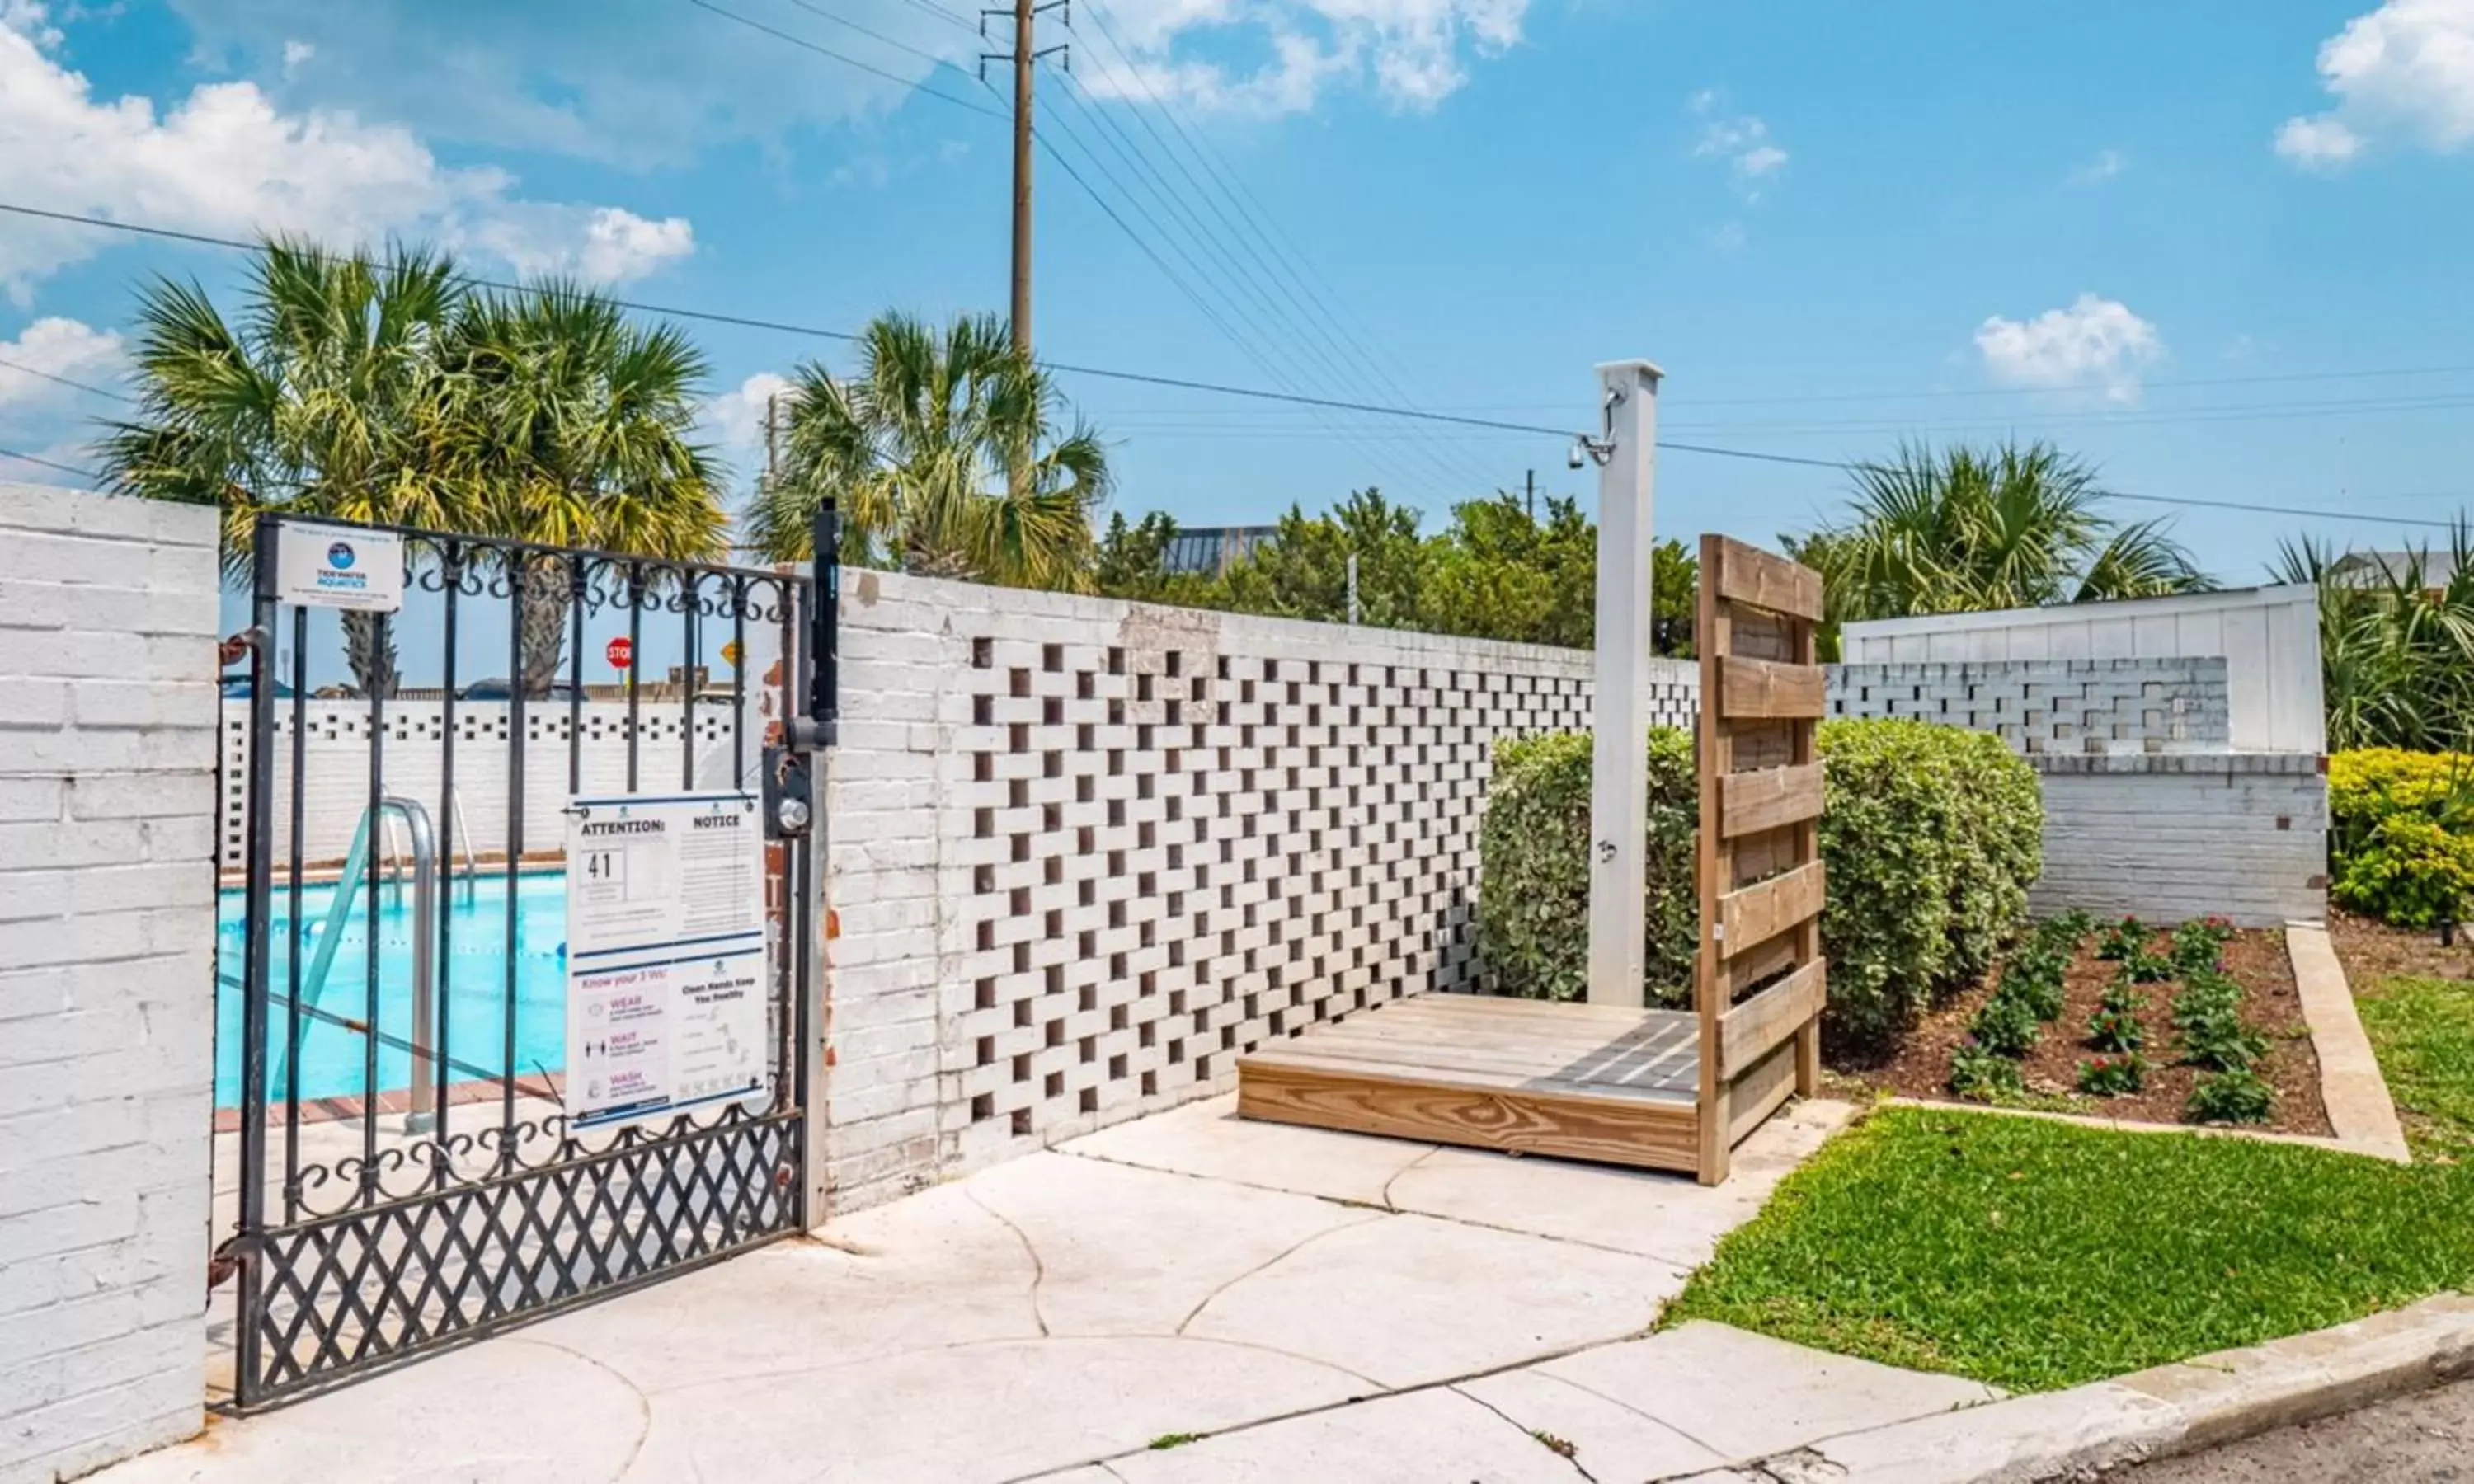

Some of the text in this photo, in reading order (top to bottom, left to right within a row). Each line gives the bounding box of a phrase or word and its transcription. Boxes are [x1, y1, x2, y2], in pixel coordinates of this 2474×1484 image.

[317, 569, 366, 579] TIDEWATER
[317, 578, 366, 588] AQUATICS
[581, 819, 666, 836] ATTENTION:
[694, 815, 741, 829] NOTICE
[588, 852, 610, 878] 41
[582, 979, 612, 989] Know
[614, 974, 637, 988] your
[610, 997, 642, 1008] WEAR
[610, 1032, 637, 1044] WAIT
[610, 1071, 642, 1085] WASH
